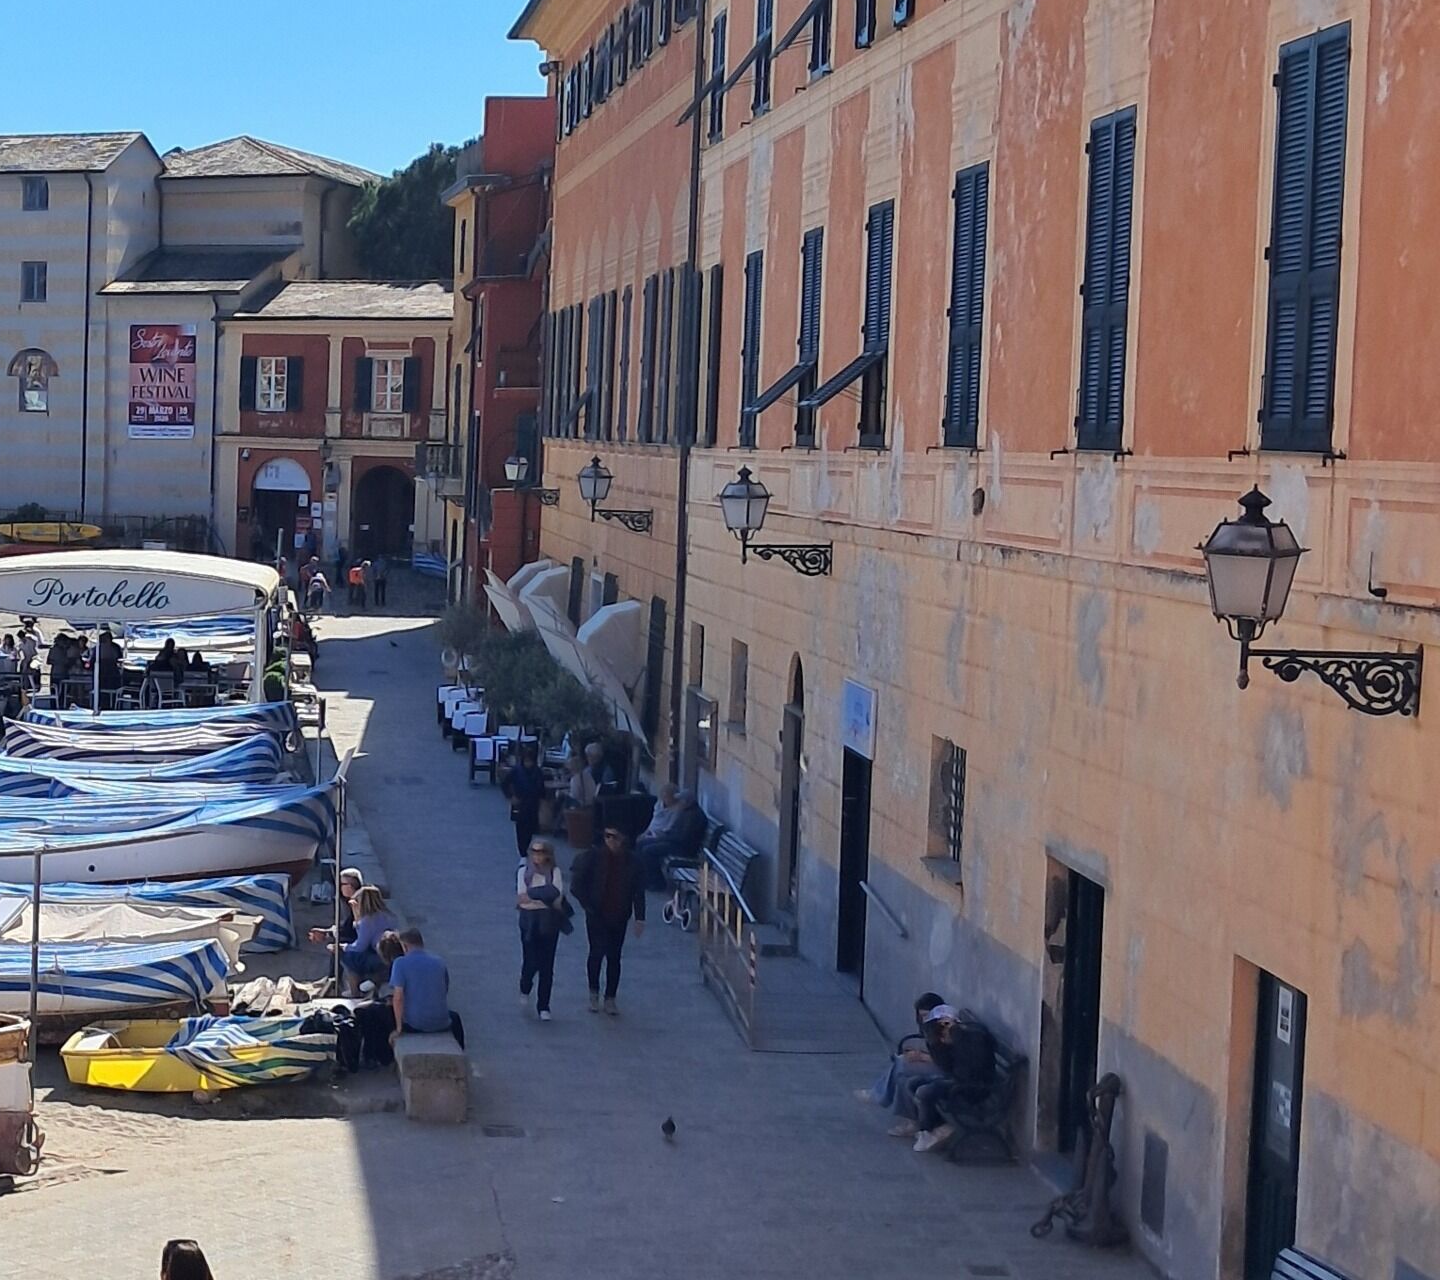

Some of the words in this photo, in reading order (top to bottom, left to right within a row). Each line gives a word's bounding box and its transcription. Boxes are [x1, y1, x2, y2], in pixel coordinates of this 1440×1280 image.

[139, 368, 185, 383] WINE
[132, 385, 191, 399] FESTIVAL
[148, 406, 174, 415] MARZO
[27, 577, 170, 610] Portobello
